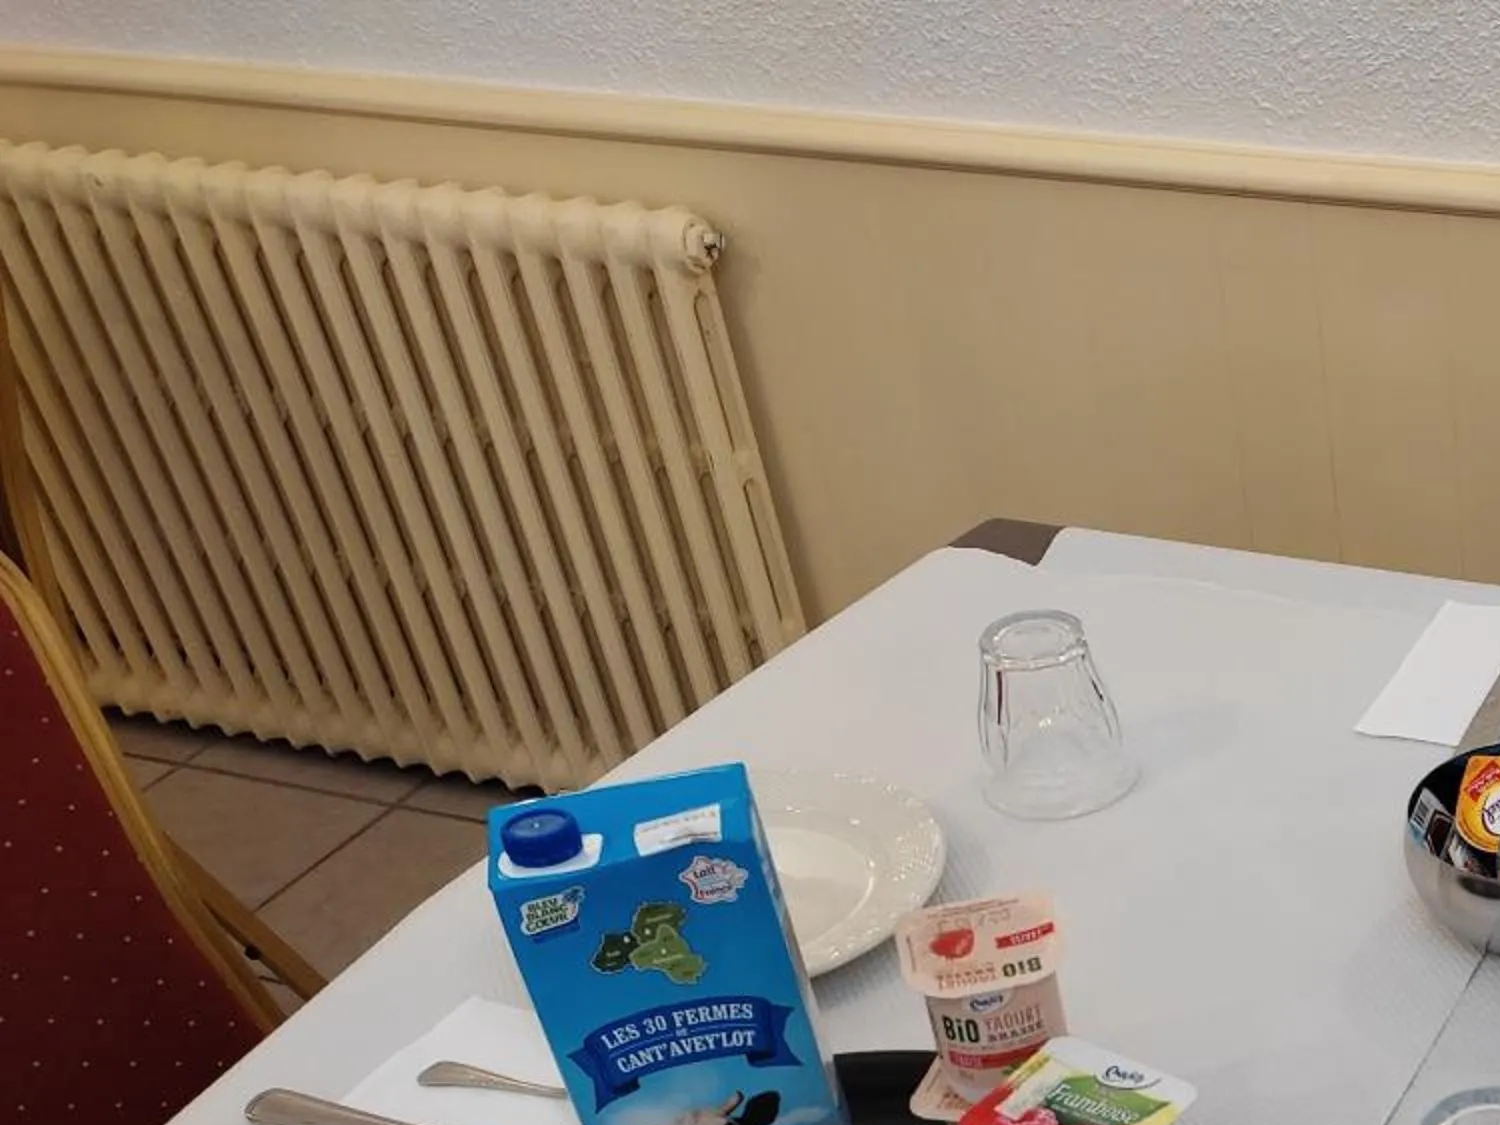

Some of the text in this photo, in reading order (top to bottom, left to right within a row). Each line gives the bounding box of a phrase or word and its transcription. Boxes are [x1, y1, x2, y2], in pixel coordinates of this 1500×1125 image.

[601, 1003, 753, 1049] LES 30 FERMES
[1047, 1083, 1140, 1124] Framboise
